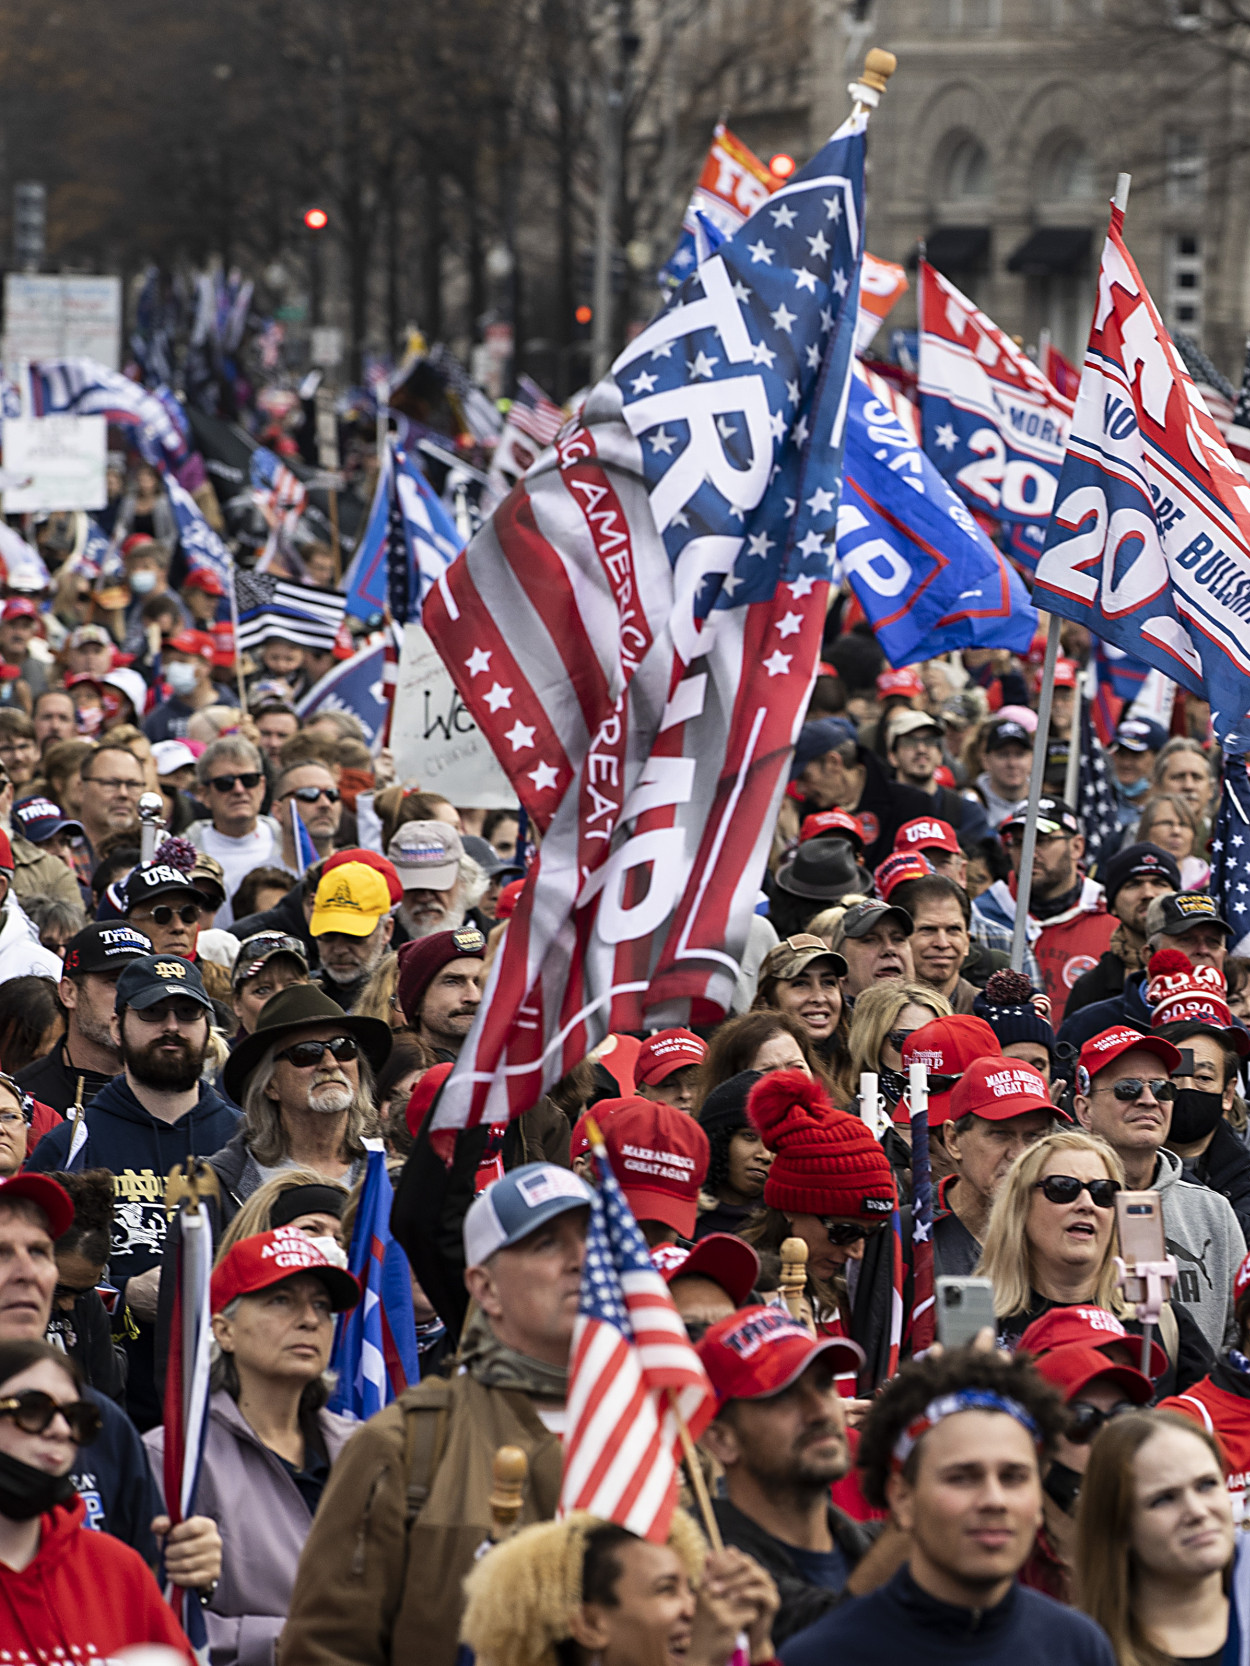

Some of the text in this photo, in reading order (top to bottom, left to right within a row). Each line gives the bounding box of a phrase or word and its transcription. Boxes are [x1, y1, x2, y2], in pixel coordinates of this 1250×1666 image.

[1104, 392, 1138, 440] NO
[905, 822, 946, 843] USA
[141, 864, 190, 887] USA
[99, 926, 153, 950] Trump
[984, 1069, 1046, 1090] MAKE AMERICA
[993, 1081, 1022, 1098] GREAT
[622, 1144, 695, 1170] MAKE AMERICA
[624, 1159, 690, 1182] GREAT AGAIN
